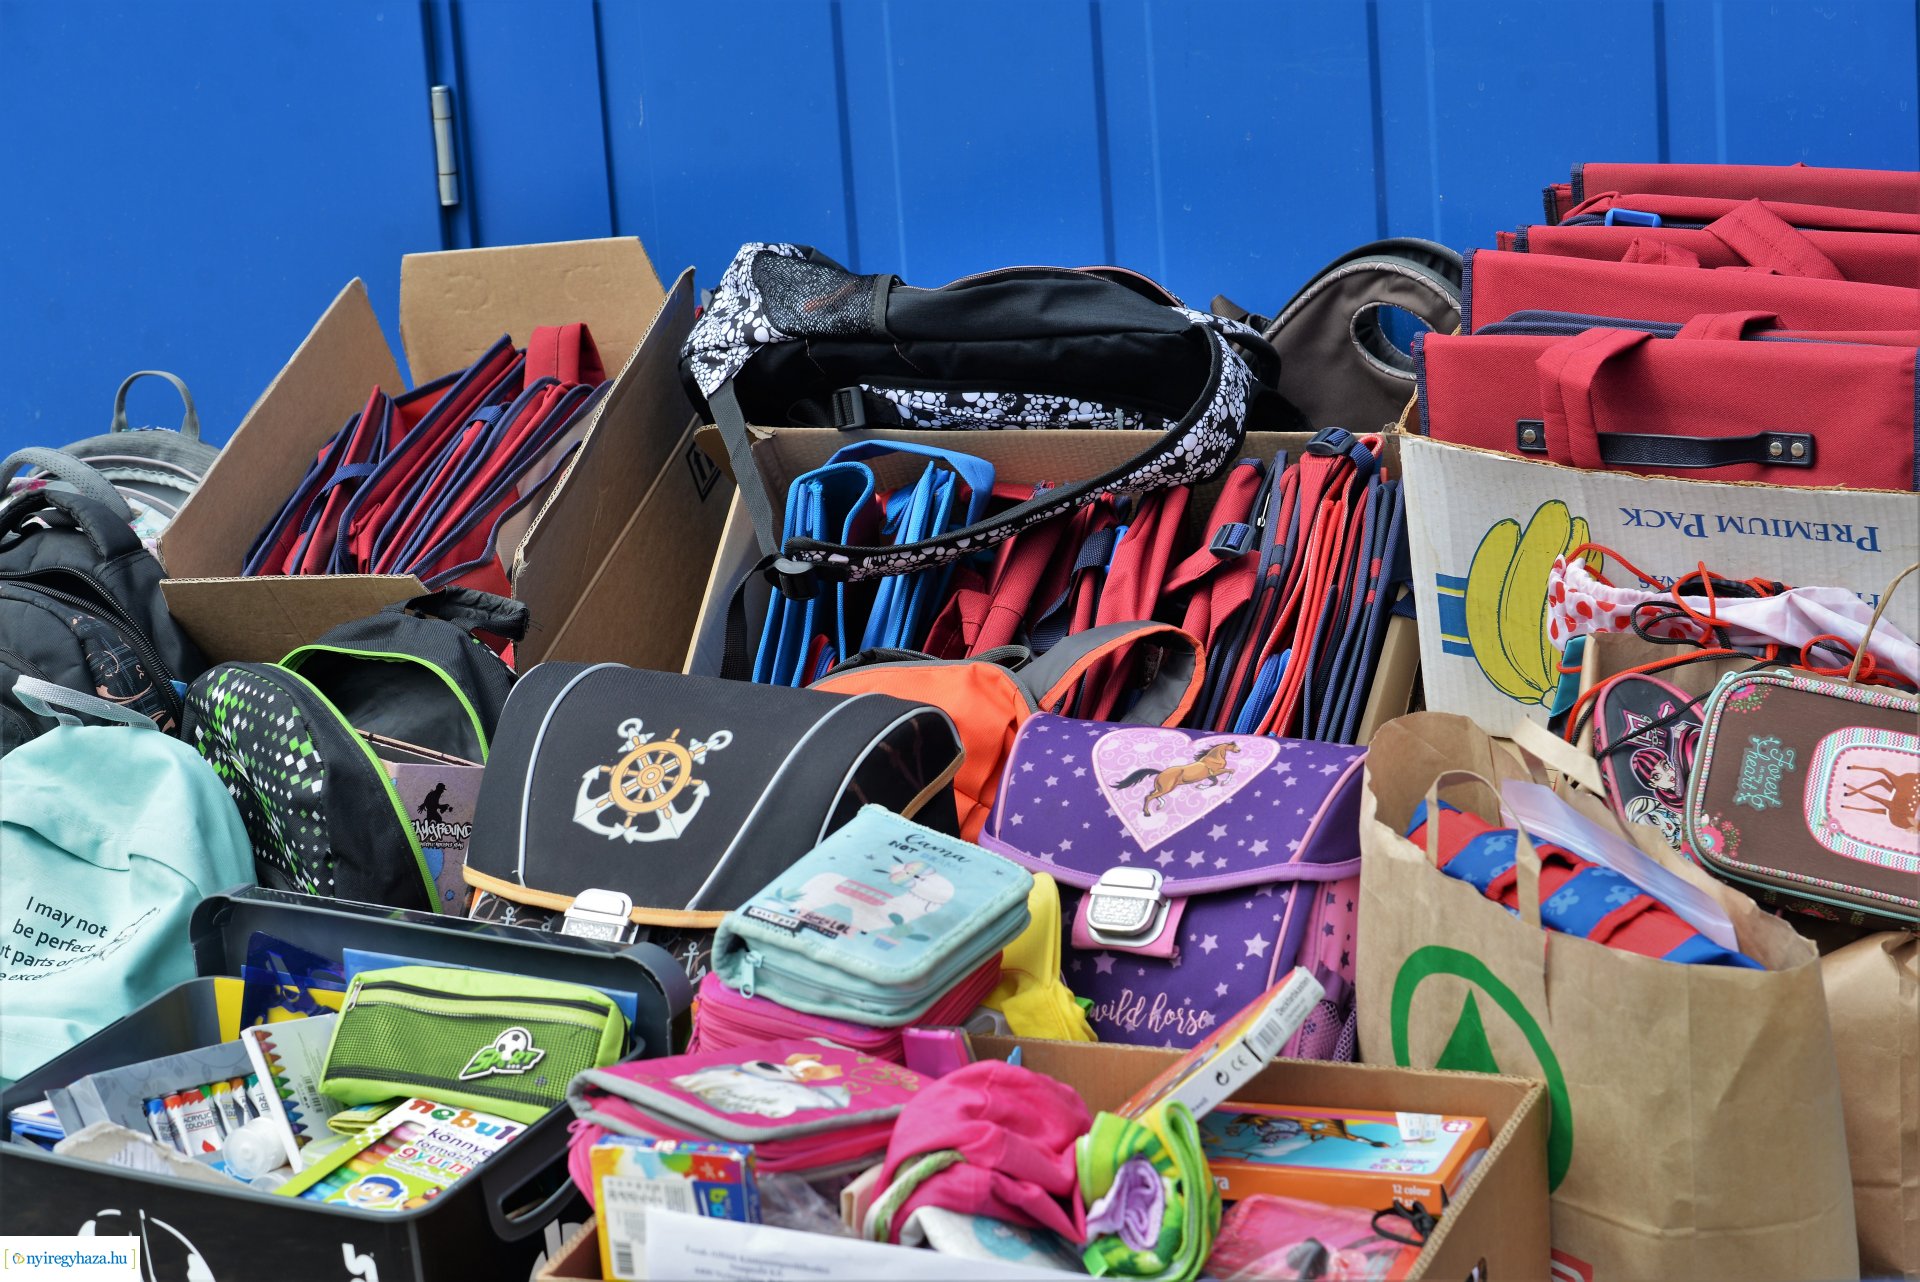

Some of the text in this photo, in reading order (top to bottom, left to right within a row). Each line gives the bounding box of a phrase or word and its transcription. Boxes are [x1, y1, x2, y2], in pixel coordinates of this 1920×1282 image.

[1618, 507, 1882, 552] PREMIUM PACK
[1741, 750, 1770, 790] heart
[888, 840, 919, 854] NOT
[26, 896, 109, 938] I may not
[12, 918, 96, 953] be perfect
[11, 951, 56, 967] parts
[1089, 989, 1209, 1036] wild horse
[183, 1111, 213, 1124] ACRYLIC
[184, 1119, 215, 1131] COLOUR
